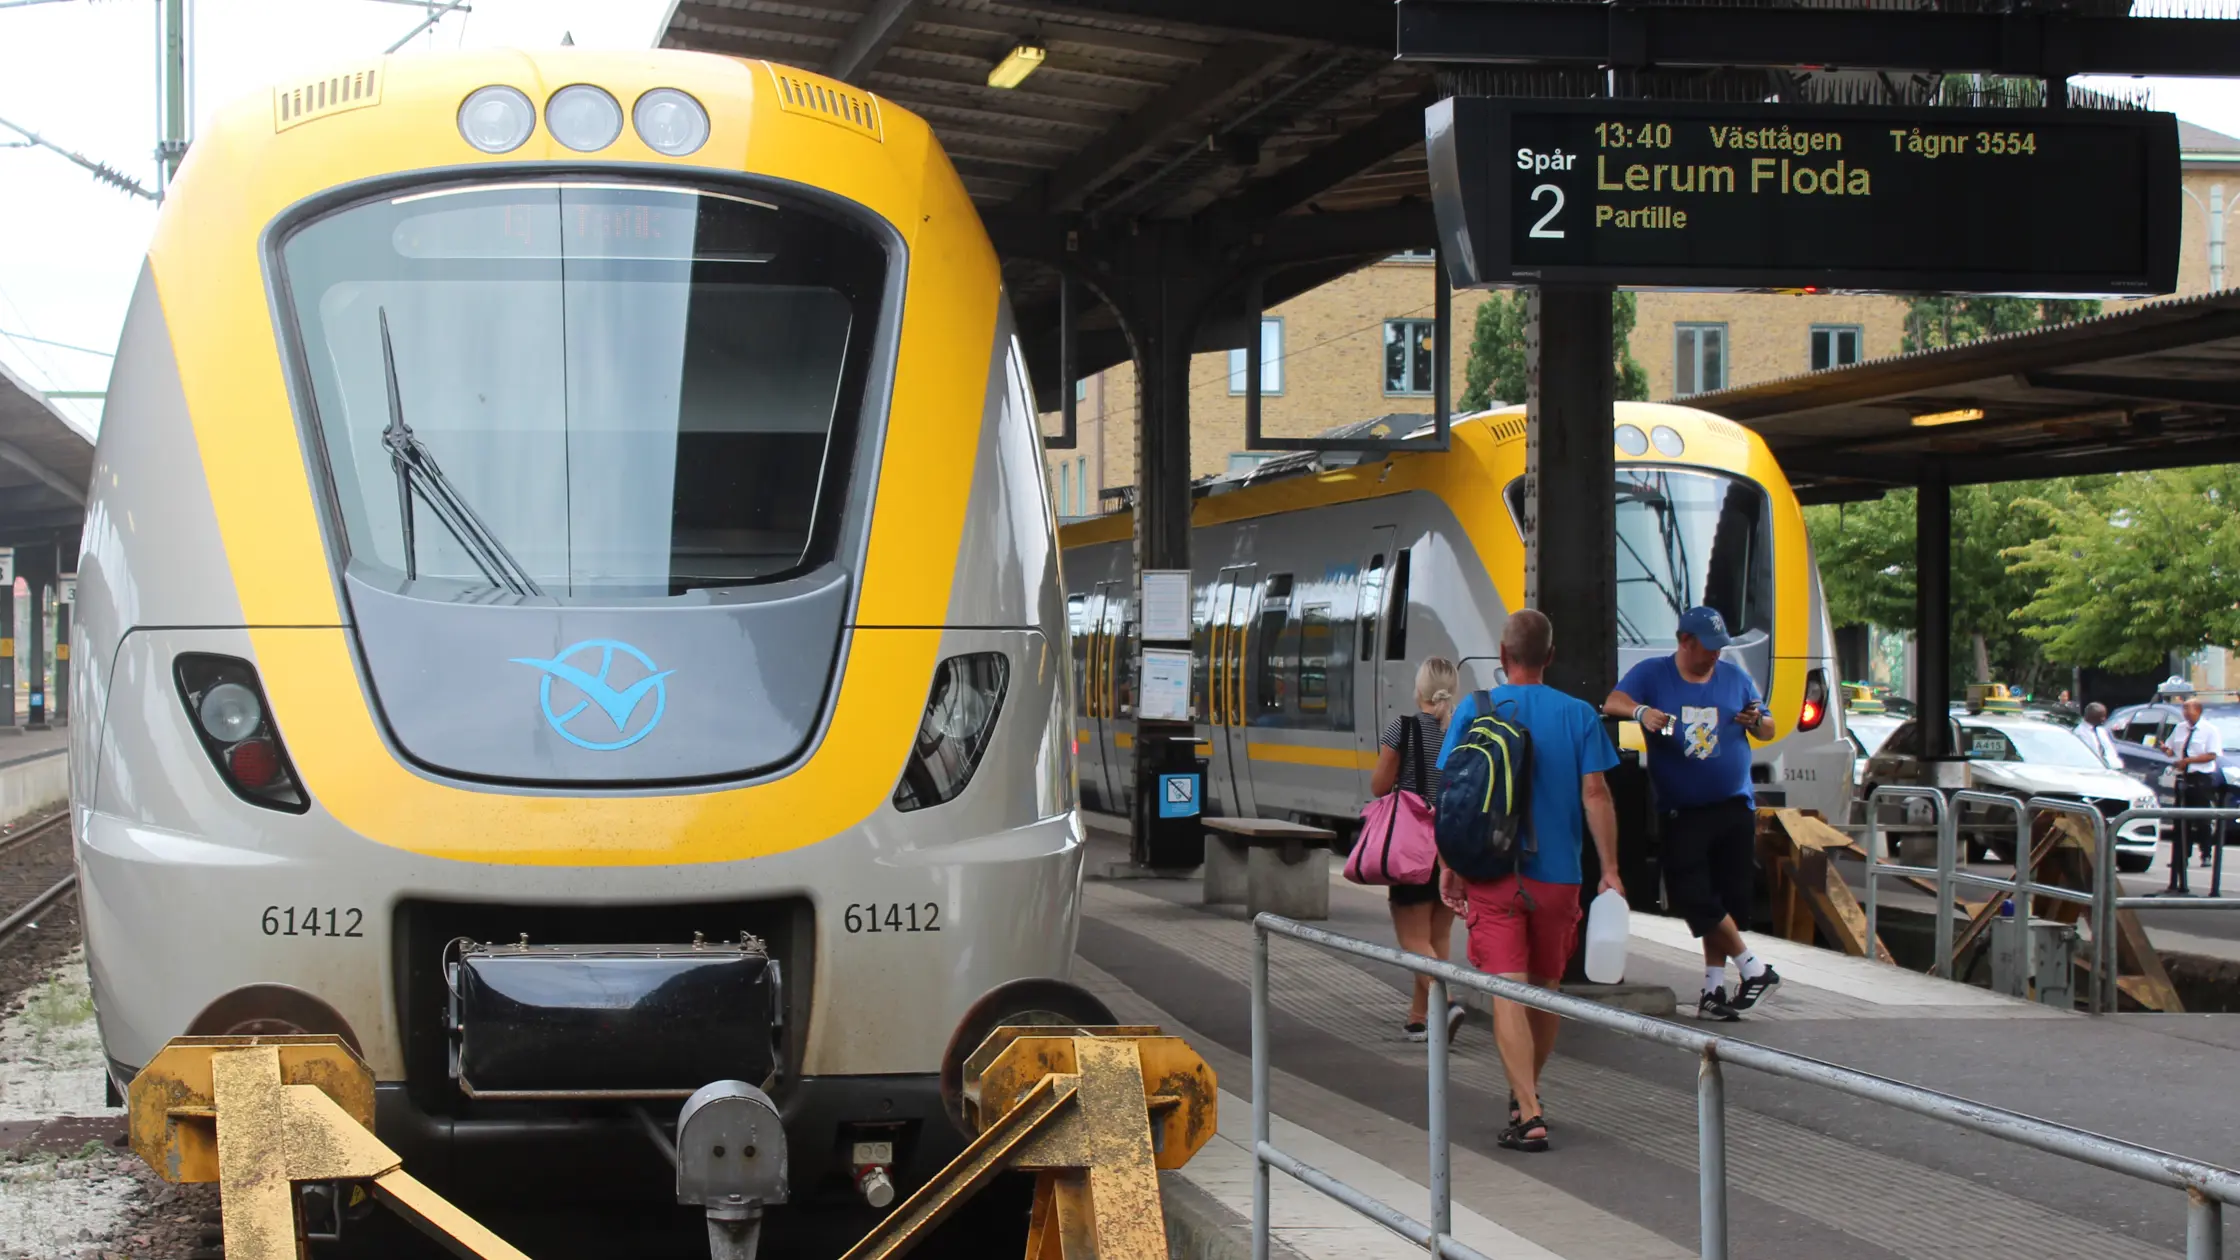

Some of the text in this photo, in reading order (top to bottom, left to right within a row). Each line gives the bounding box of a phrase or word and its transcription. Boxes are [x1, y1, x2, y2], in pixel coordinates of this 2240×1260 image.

[1595, 122, 2036, 159] 13:40 Västtågen Tågnr 3554
[1517, 148, 1576, 174] Spår
[1597, 155, 1870, 195] Lerum Floda
[1529, 184, 1565, 238] 2
[1596, 205, 1687, 228] Partille
[262, 905, 363, 938] 61412
[844, 902, 941, 934] 61412
